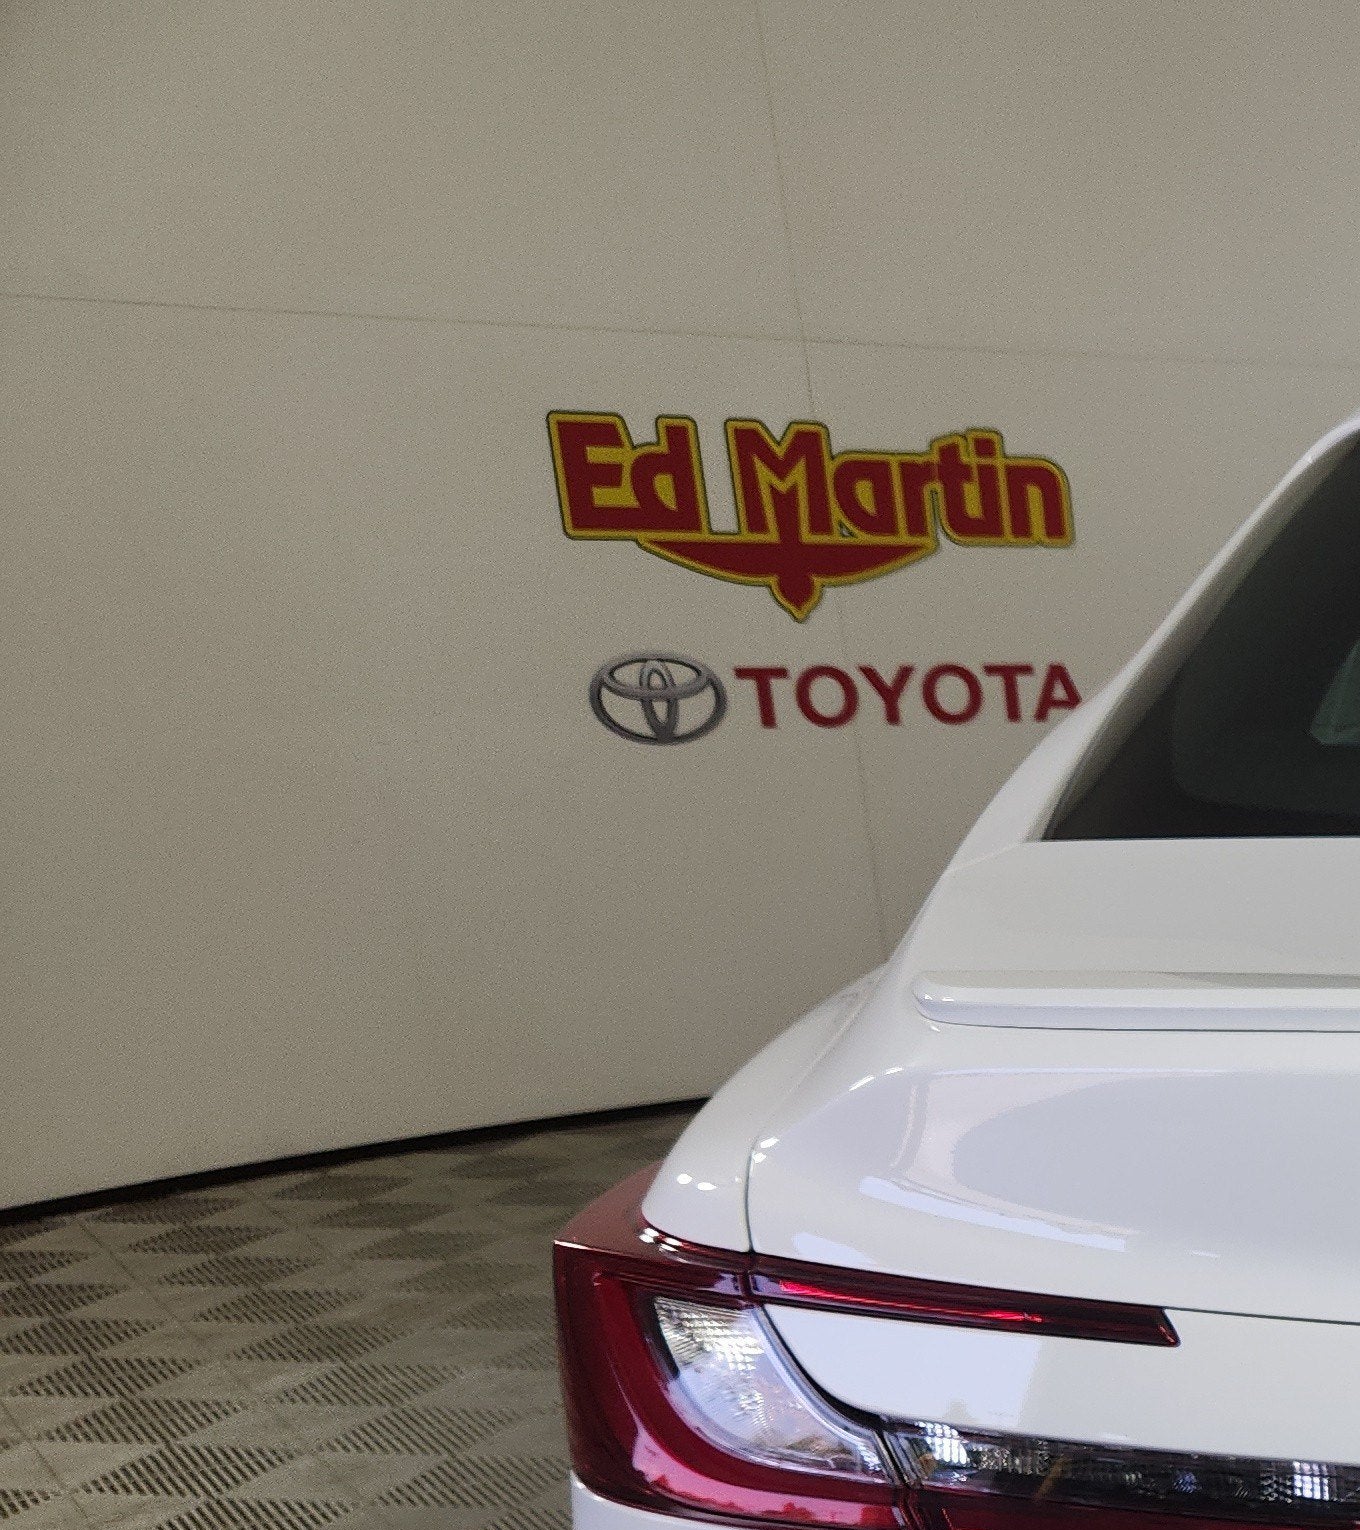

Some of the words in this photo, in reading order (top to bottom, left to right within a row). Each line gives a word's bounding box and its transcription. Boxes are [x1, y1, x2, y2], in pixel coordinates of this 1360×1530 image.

[547, 410, 709, 540] Ed
[726, 417, 1074, 547] Martin
[735, 663, 1083, 729] TOYOTA
